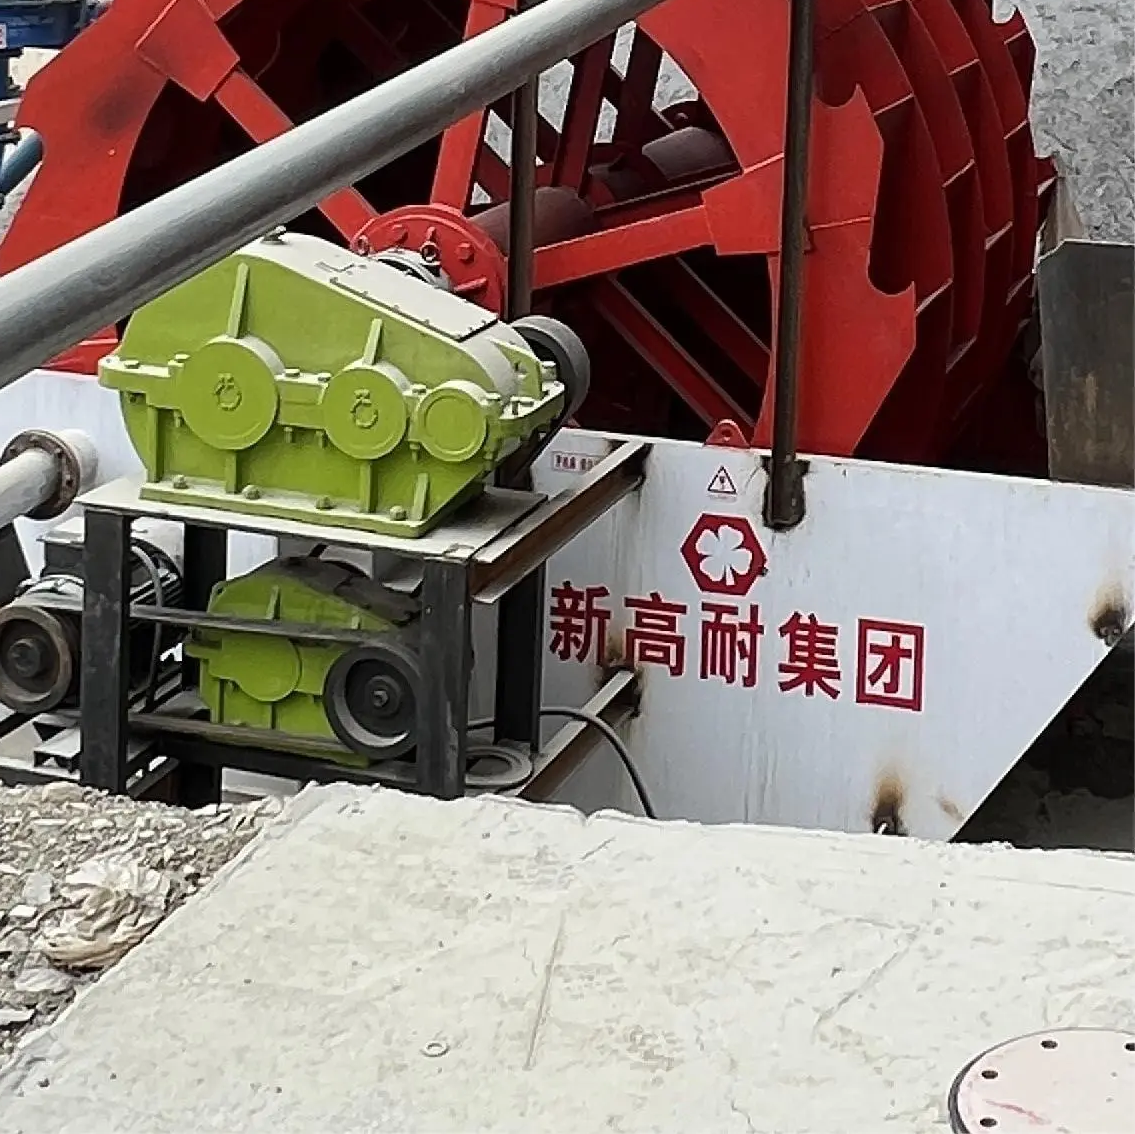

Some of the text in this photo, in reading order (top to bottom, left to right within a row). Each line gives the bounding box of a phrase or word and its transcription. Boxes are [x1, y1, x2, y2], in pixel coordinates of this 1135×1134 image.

[549, 580, 925, 712] 新高耐集团
